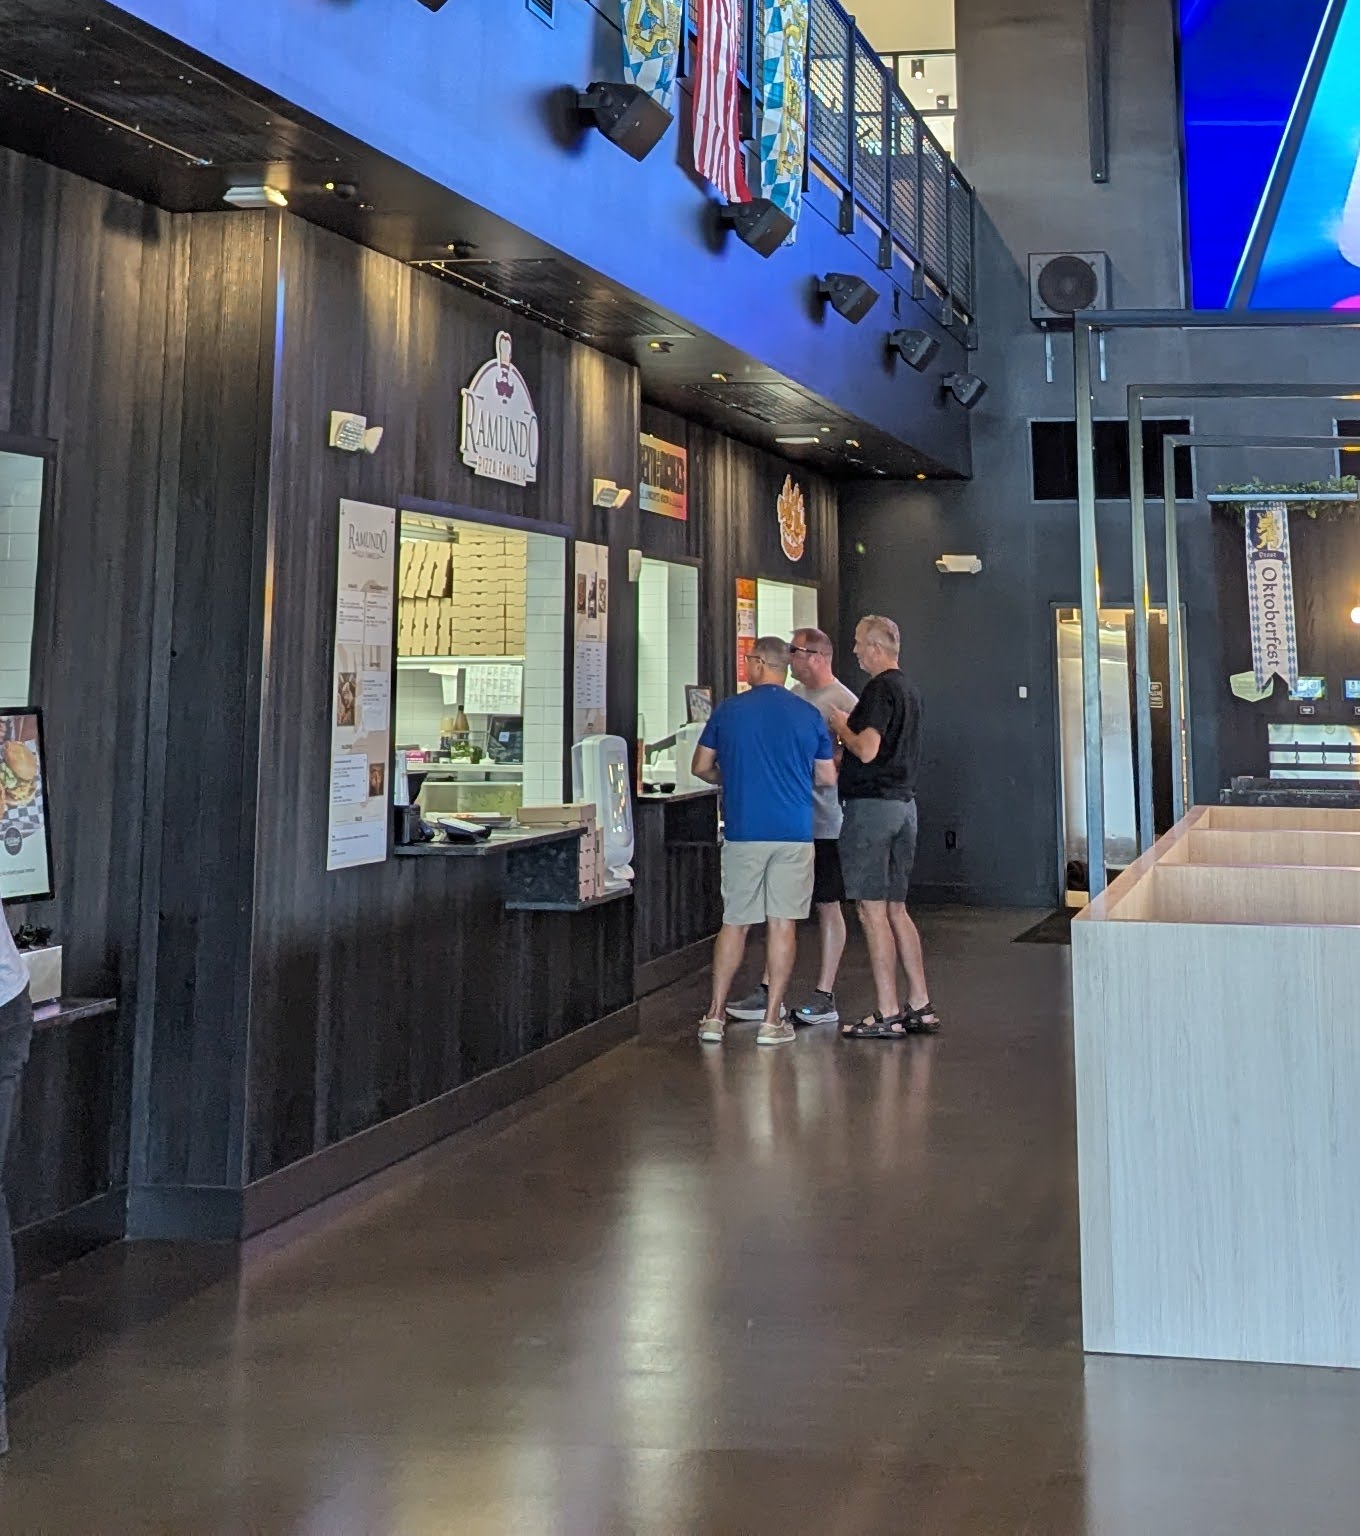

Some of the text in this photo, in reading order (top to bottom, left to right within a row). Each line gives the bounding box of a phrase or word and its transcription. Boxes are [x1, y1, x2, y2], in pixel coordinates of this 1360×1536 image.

[463, 392, 539, 467] RAMUNDO
[478, 455, 496, 475] PIZZA
[348, 523, 388, 554] RAMUNDO
[1261, 566, 1282, 668] Oktoberfest
